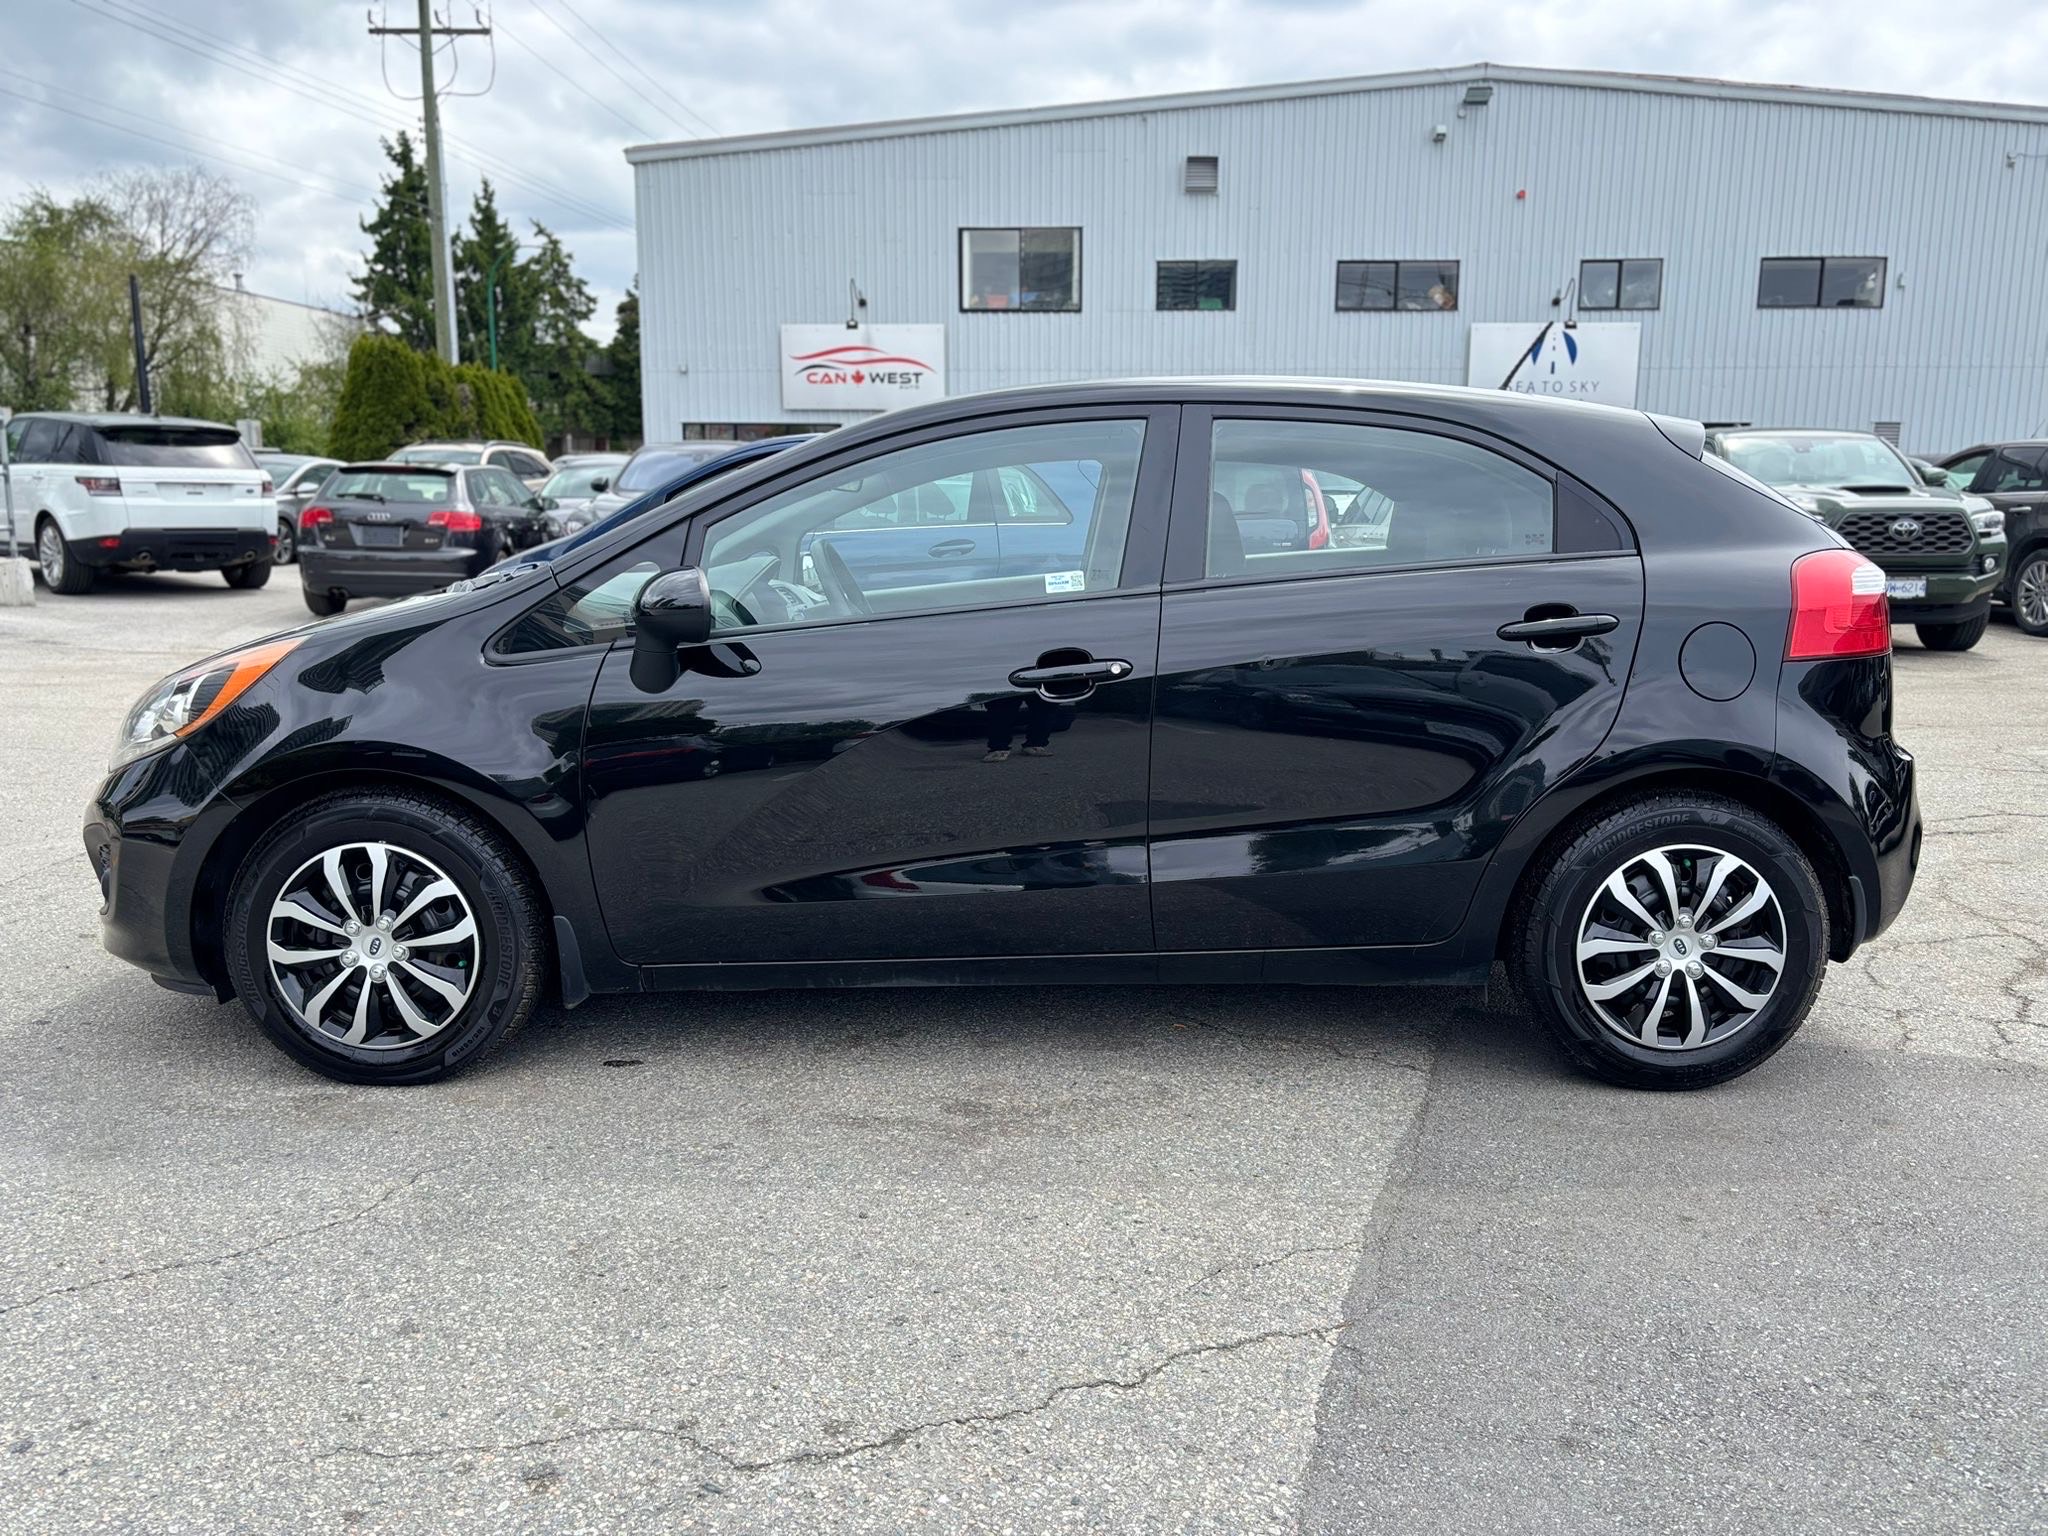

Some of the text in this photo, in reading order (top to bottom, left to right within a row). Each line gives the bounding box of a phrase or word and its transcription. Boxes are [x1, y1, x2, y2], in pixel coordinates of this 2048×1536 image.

[806, 372, 923, 384] CAN WEST
[1542, 380, 1563, 393] TO
[1569, 380, 1601, 393] SKY
[1592, 812, 1690, 857] BRIDGESTONE
[486, 889, 513, 990] BRIDGESTONE
